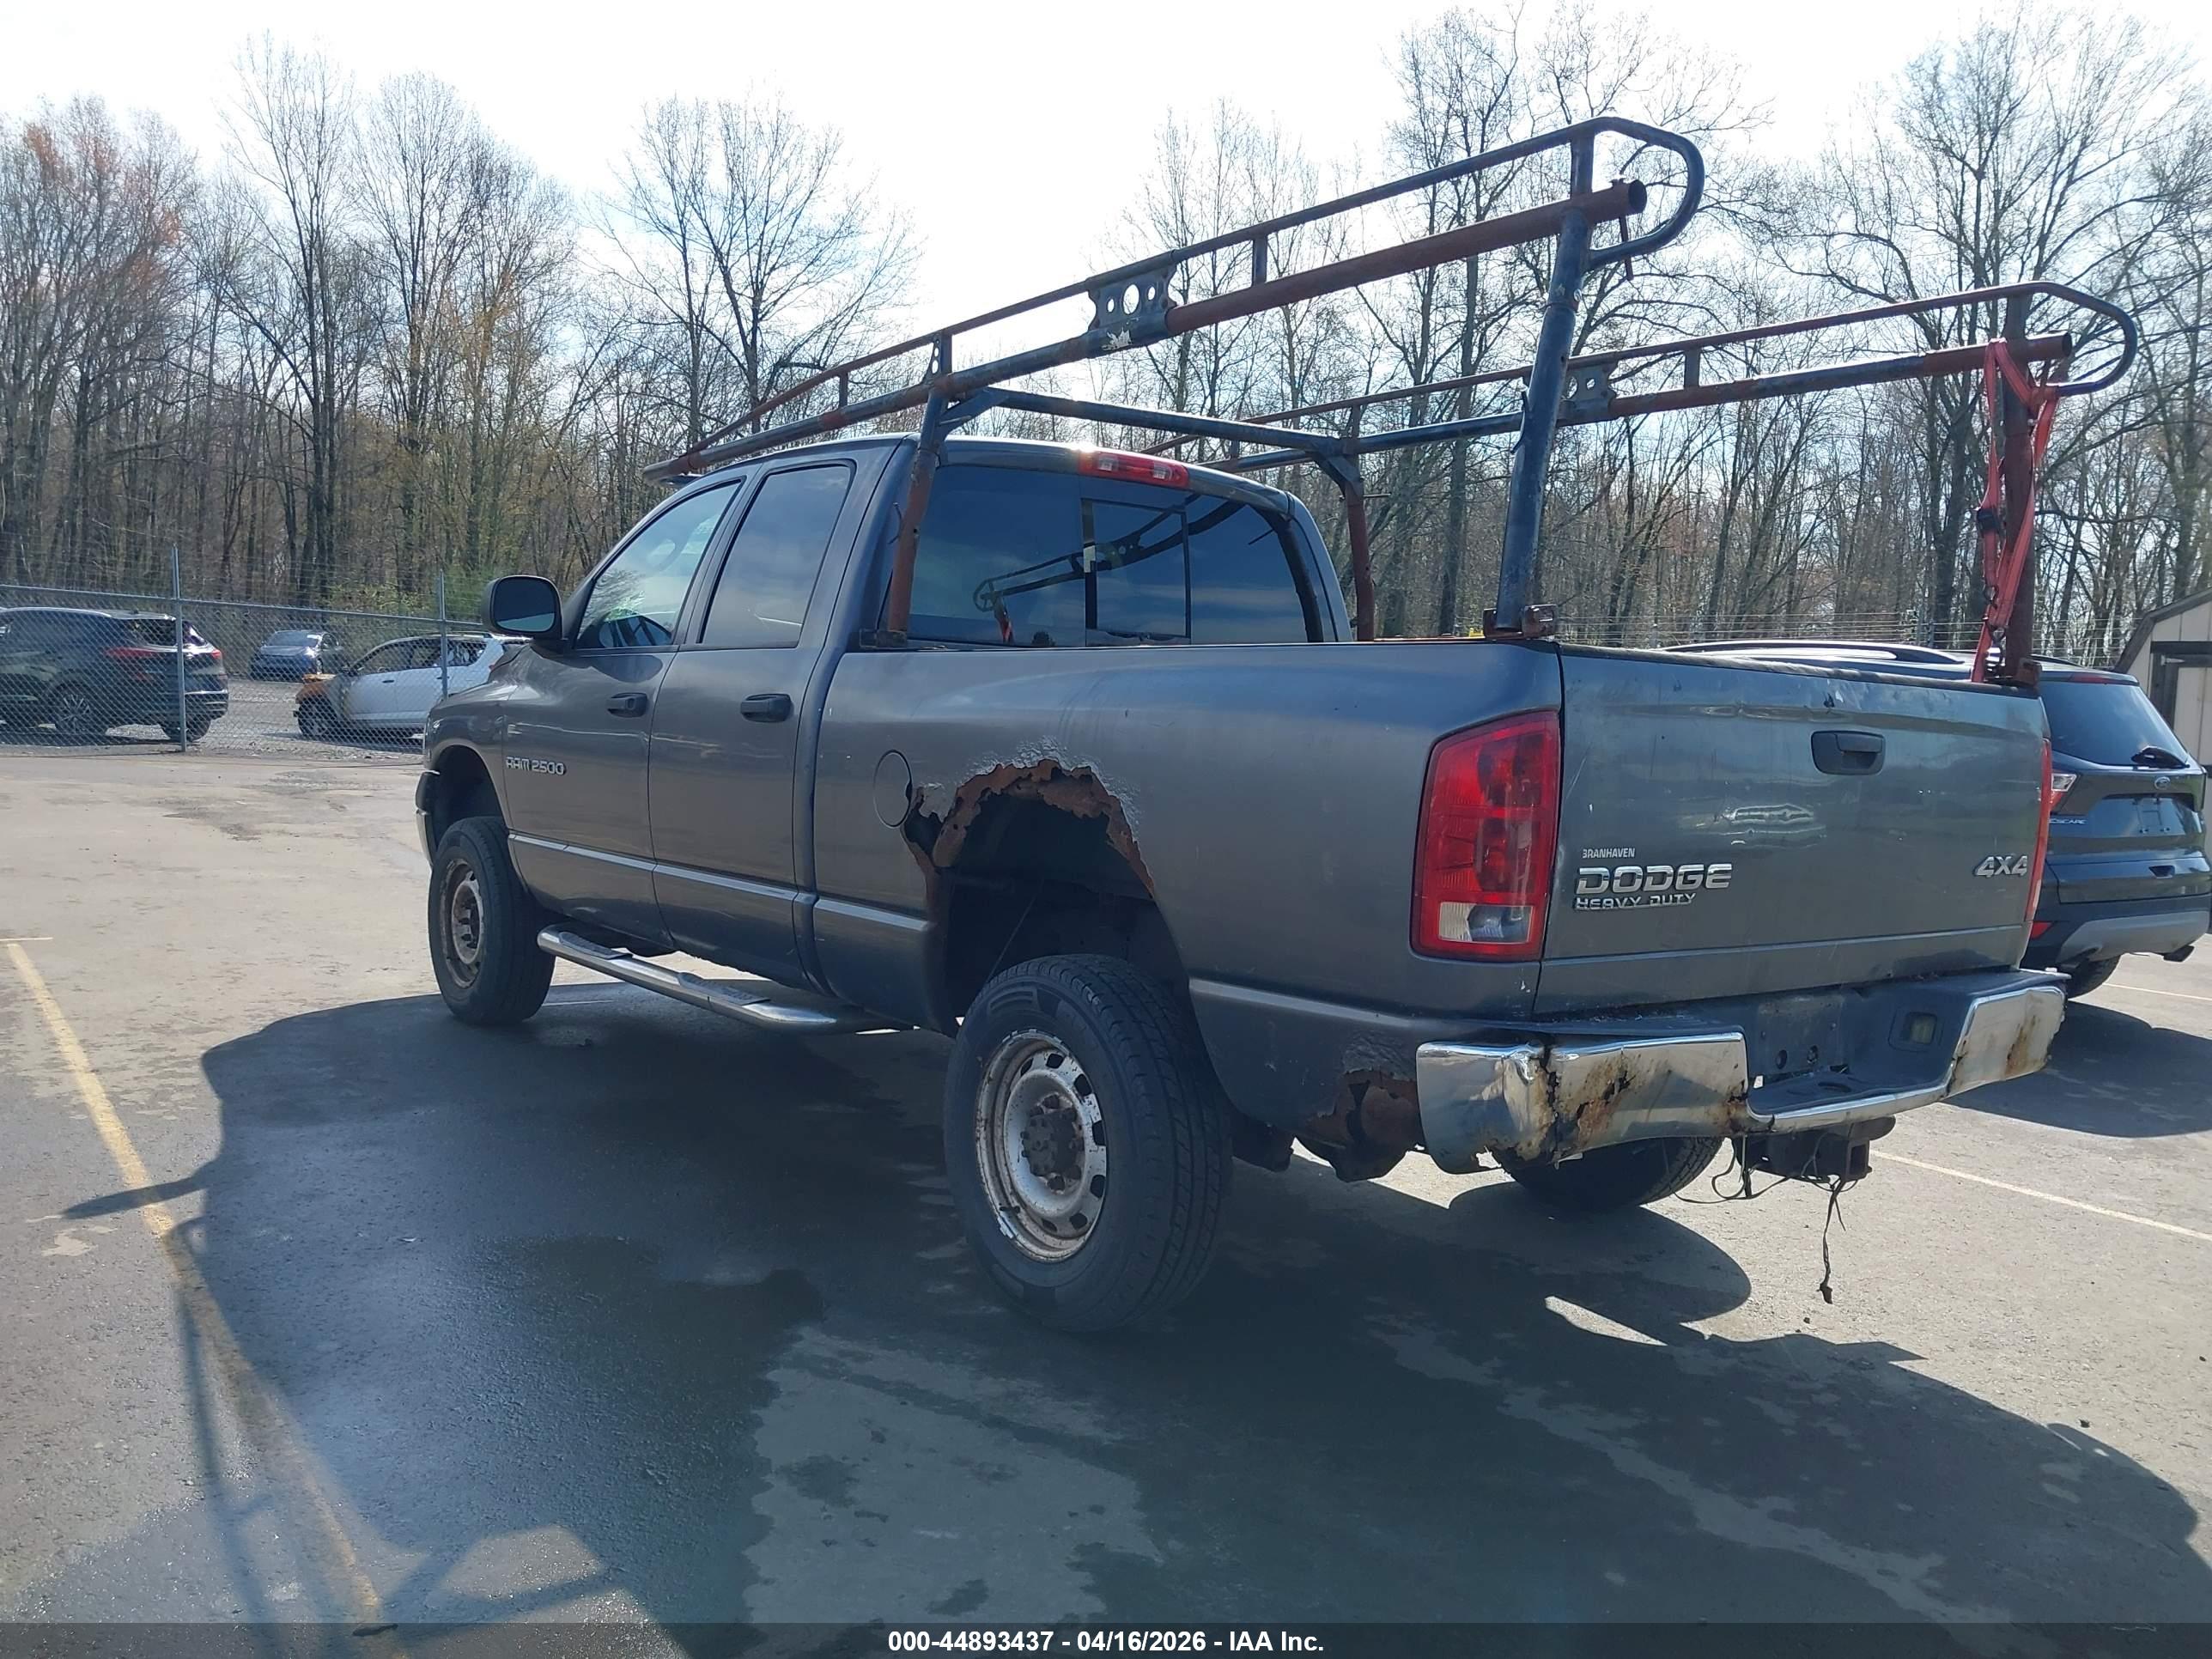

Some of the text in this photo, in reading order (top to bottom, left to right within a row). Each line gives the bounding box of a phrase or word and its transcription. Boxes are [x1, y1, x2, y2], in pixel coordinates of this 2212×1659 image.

[506, 757, 565, 775] RAM 2500
[1577, 863, 1732, 895] DODGE
[1575, 893, 1696, 910] HEAVY DUTY
